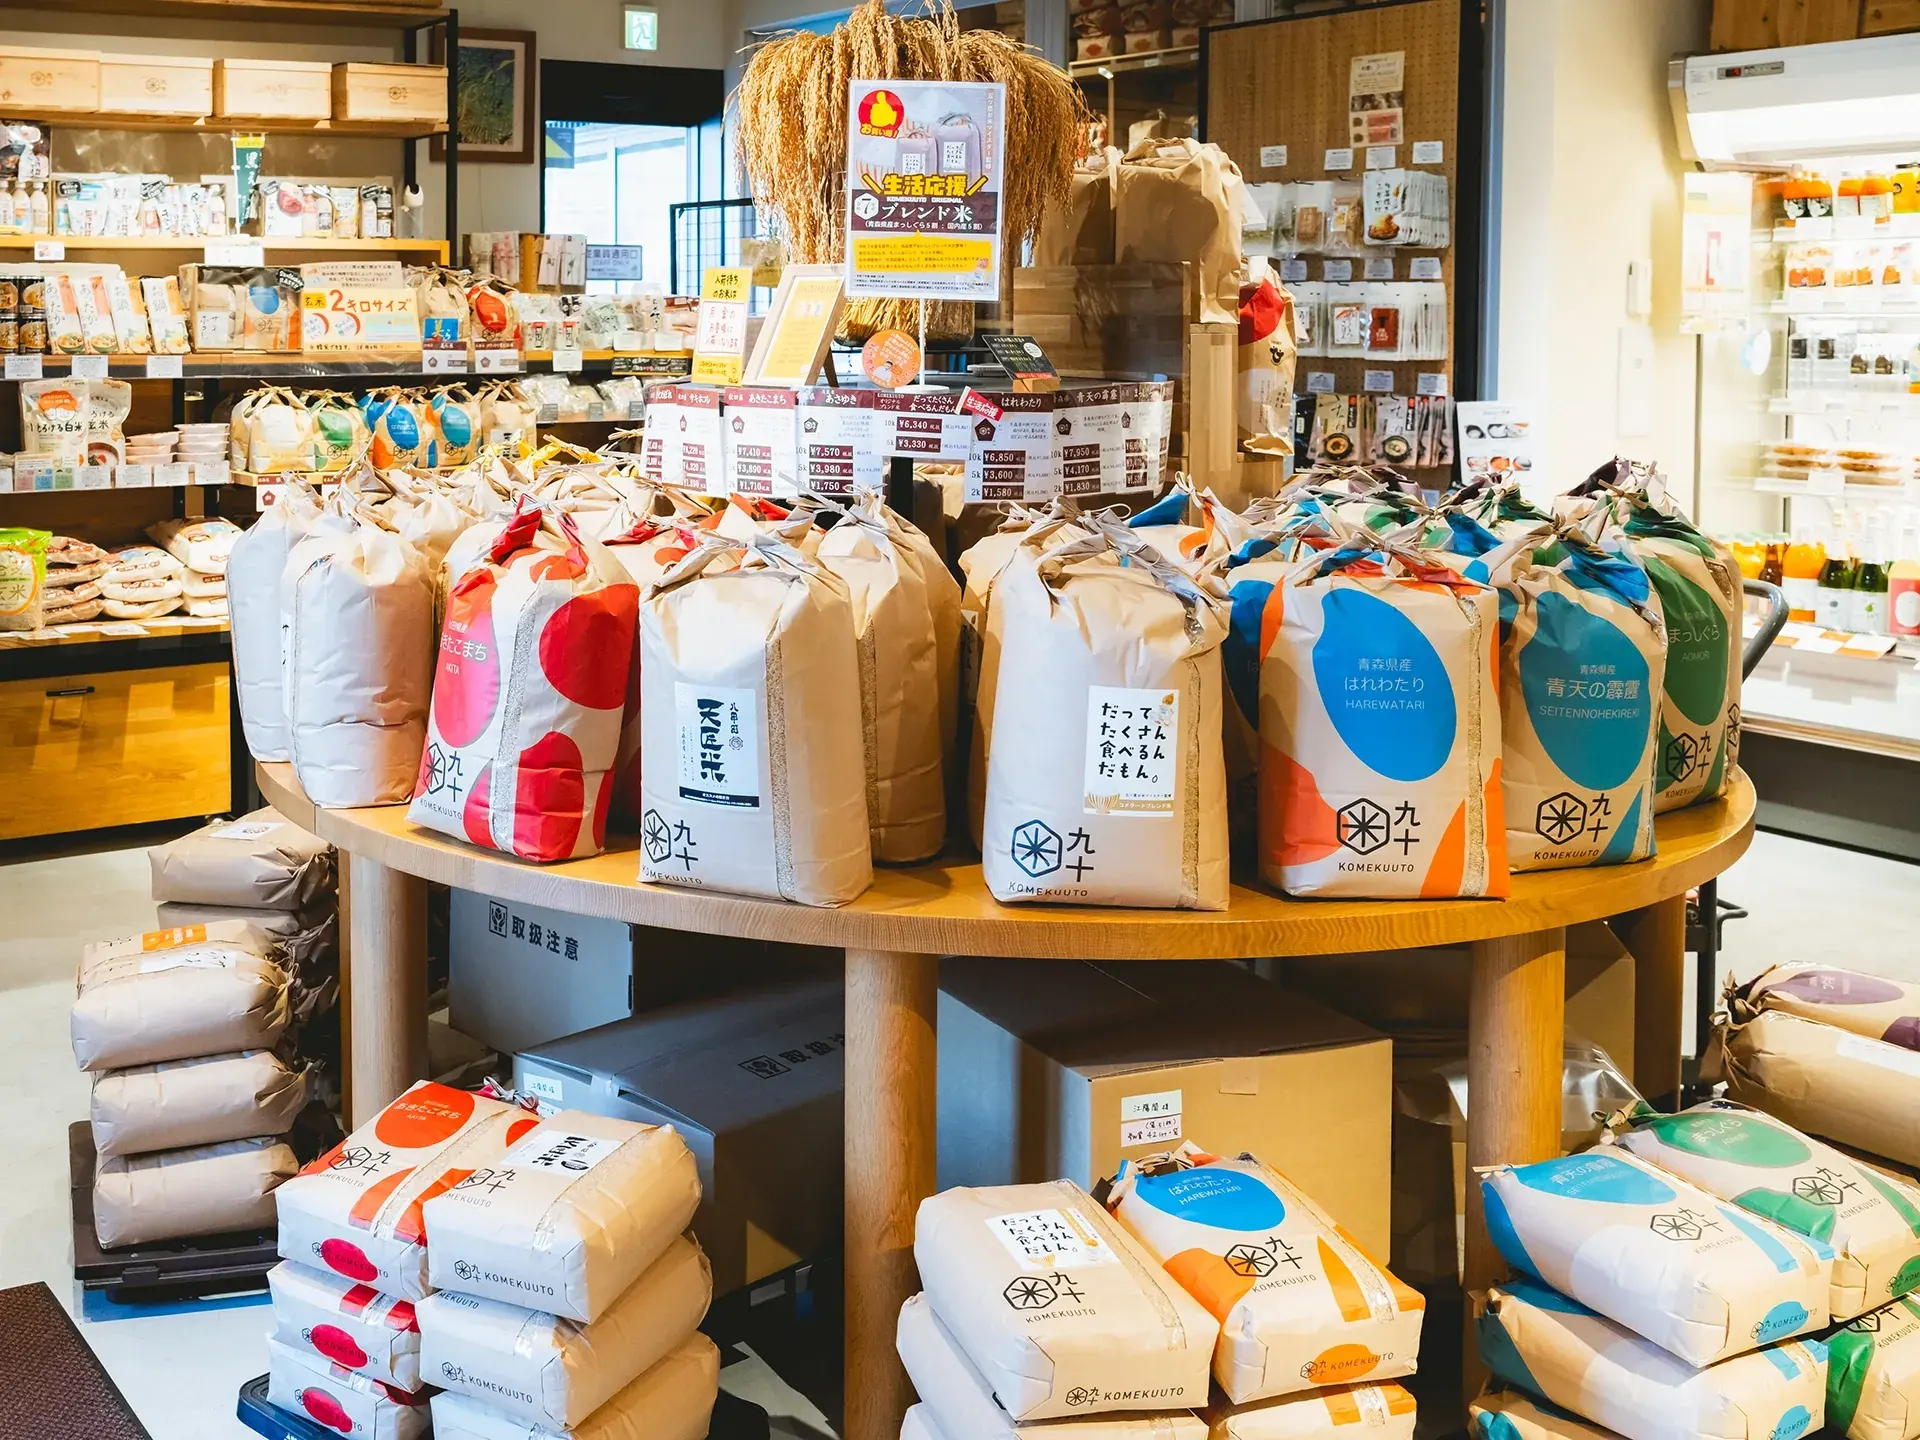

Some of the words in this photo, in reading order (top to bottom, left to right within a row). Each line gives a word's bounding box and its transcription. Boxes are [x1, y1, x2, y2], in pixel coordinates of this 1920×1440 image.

[882, 174, 968, 197] 生活応援
[861, 198, 872, 215] 7
[881, 202, 973, 222] ブレンド米
[748, 394, 787, 405] あきたこまち
[825, 394, 857, 405] あさゆき
[913, 395, 955, 404] だってたくさん
[966, 395, 999, 418] 生活応援
[1001, 397, 1042, 409] はれわたり
[899, 419, 928, 430] ¥6,340
[810, 446, 840, 457] ¥7,570
[898, 439, 927, 449] ¥3,330
[1051, 450, 1062, 458] 10k
[1064, 447, 1090, 458] ¥7,950
[969, 454, 982, 462] 10k
[984, 453, 1014, 463] ¥6,850
[810, 464, 841, 474] ¥3,980
[971, 471, 981, 479] 5k
[984, 470, 1013, 480] ¥3,600
[1053, 467, 1062, 475] 5k
[1065, 465, 1090, 475] ¥4,170
[810, 480, 840, 491] ¥1,750
[971, 488, 981, 496] 2k
[983, 487, 1012, 497] ¥1,580
[1053, 485, 1062, 493] 2k
[1065, 481, 1090, 492] ¥1,830
[1667, 623, 1721, 645] まっしぐら
[440, 634, 488, 661] きたこまち
[1357, 657, 1413, 673] 青森県産
[1579, 664, 1617, 676] 青森県産
[1343, 676, 1426, 693] はれわたり
[1545, 677, 1642, 701] 青天の霹靂
[1101, 703, 1153, 720] だって
[1344, 698, 1426, 711] HAREWATARI
[1539, 704, 1641, 720] SEITENNOHEKIREKI
[697, 698, 726, 783] 天匠米
[1100, 721, 1167, 741] たくさん
[1099, 740, 1165, 761] 食べるん
[1697, 730, 1712, 778] 九十
[447, 750, 463, 802] 九十
[1098, 761, 1159, 784] だもん。
[419, 798, 463, 821] KOMEKUUTO
[1586, 792, 1612, 843] 九十
[1392, 800, 1421, 857] 九十
[673, 819, 699, 872] 九十
[1065, 826, 1096, 883] 九十
[1533, 848, 1600, 861] KOMEKUUTO
[1337, 862, 1415, 874] KOMEKUUTO
[1008, 881, 1089, 897] KOMEKUUTO
[510, 914, 579, 962] 取扱注意
[778, 1033, 845, 1064] 取扱
[393, 1103, 462, 1120] あきたこまち
[362, 1150, 392, 1176] 九十
[486, 1168, 516, 1194] 九十
[1168, 1177, 1232, 1197] はれわたり
[1815, 1166, 1863, 1195] 九十
[441, 1192, 492, 1209] OMEKUUTO
[1178, 1185, 1243, 1206] HAREWATARI
[1839, 1197, 1882, 1220] KOMEKUUTO
[1001, 1214, 1043, 1227] だって
[1008, 1222, 1066, 1236] たくさん
[1678, 1206, 1724, 1233] 九十
[1016, 1231, 1074, 1246] 食べるん
[1694, 1235, 1743, 1255] KOMEKUUTO
[1264, 1236, 1303, 1270] 九十
[471, 1263, 482, 1283] 九十
[484, 1272, 555, 1297] KOMEKUUTO
[1048, 1270, 1086, 1304] 九十
[1251, 1274, 1318, 1294] KOMEKUUTO
[438, 1291, 480, 1310] MEKUUTO
[1025, 1307, 1097, 1325] KOMEKUUTO
[1772, 1308, 1818, 1329] KOMEKUUTO
[1876, 1321, 1920, 1349] KOMEKUUTO
[1329, 1352, 1394, 1371] KOMEKUUTO
[468, 1375, 533, 1404] KOMEKUUTO
[1088, 1386, 1100, 1406] 九十
[1103, 1386, 1185, 1402] KOMEKUUTO
